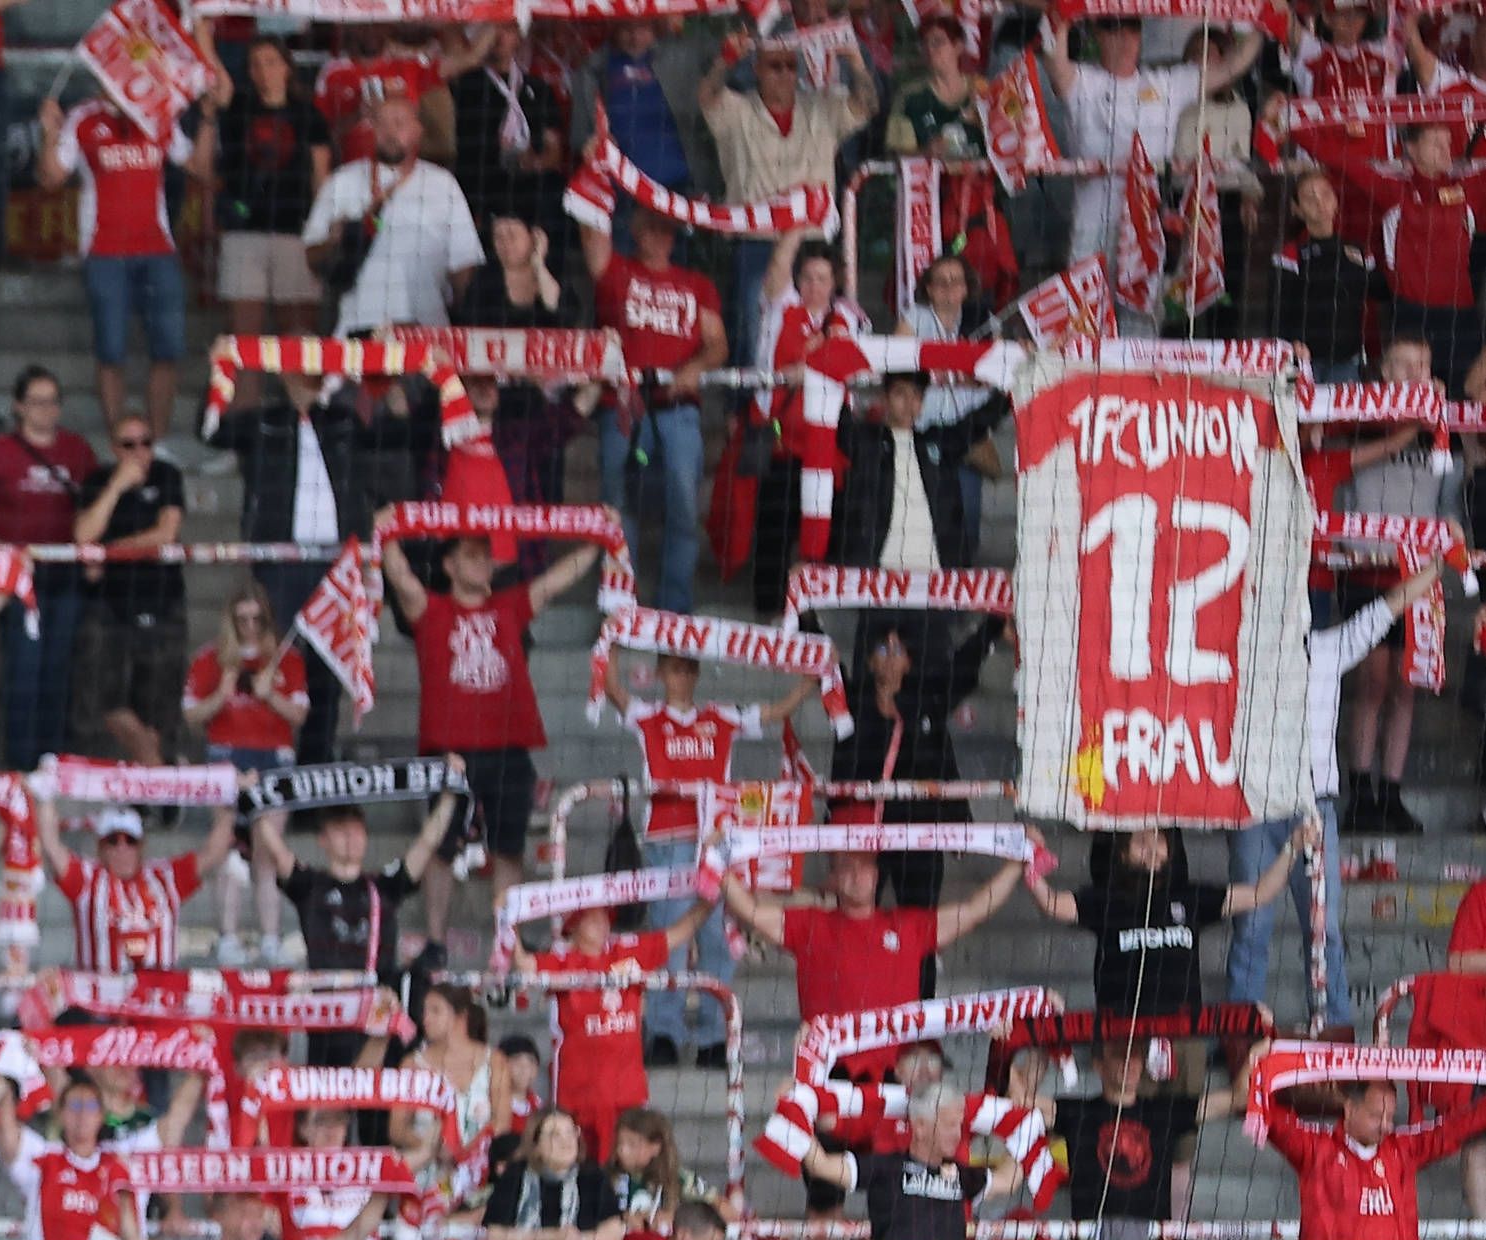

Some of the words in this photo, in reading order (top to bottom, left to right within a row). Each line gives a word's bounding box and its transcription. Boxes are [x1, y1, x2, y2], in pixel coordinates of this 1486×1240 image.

[1080, 492, 1251, 686] 12
[1103, 706, 1238, 791] FRAU
[290, 1066, 376, 1102] UNION
[129, 1155, 252, 1187] EISERN
[264, 1152, 384, 1187] UNION
